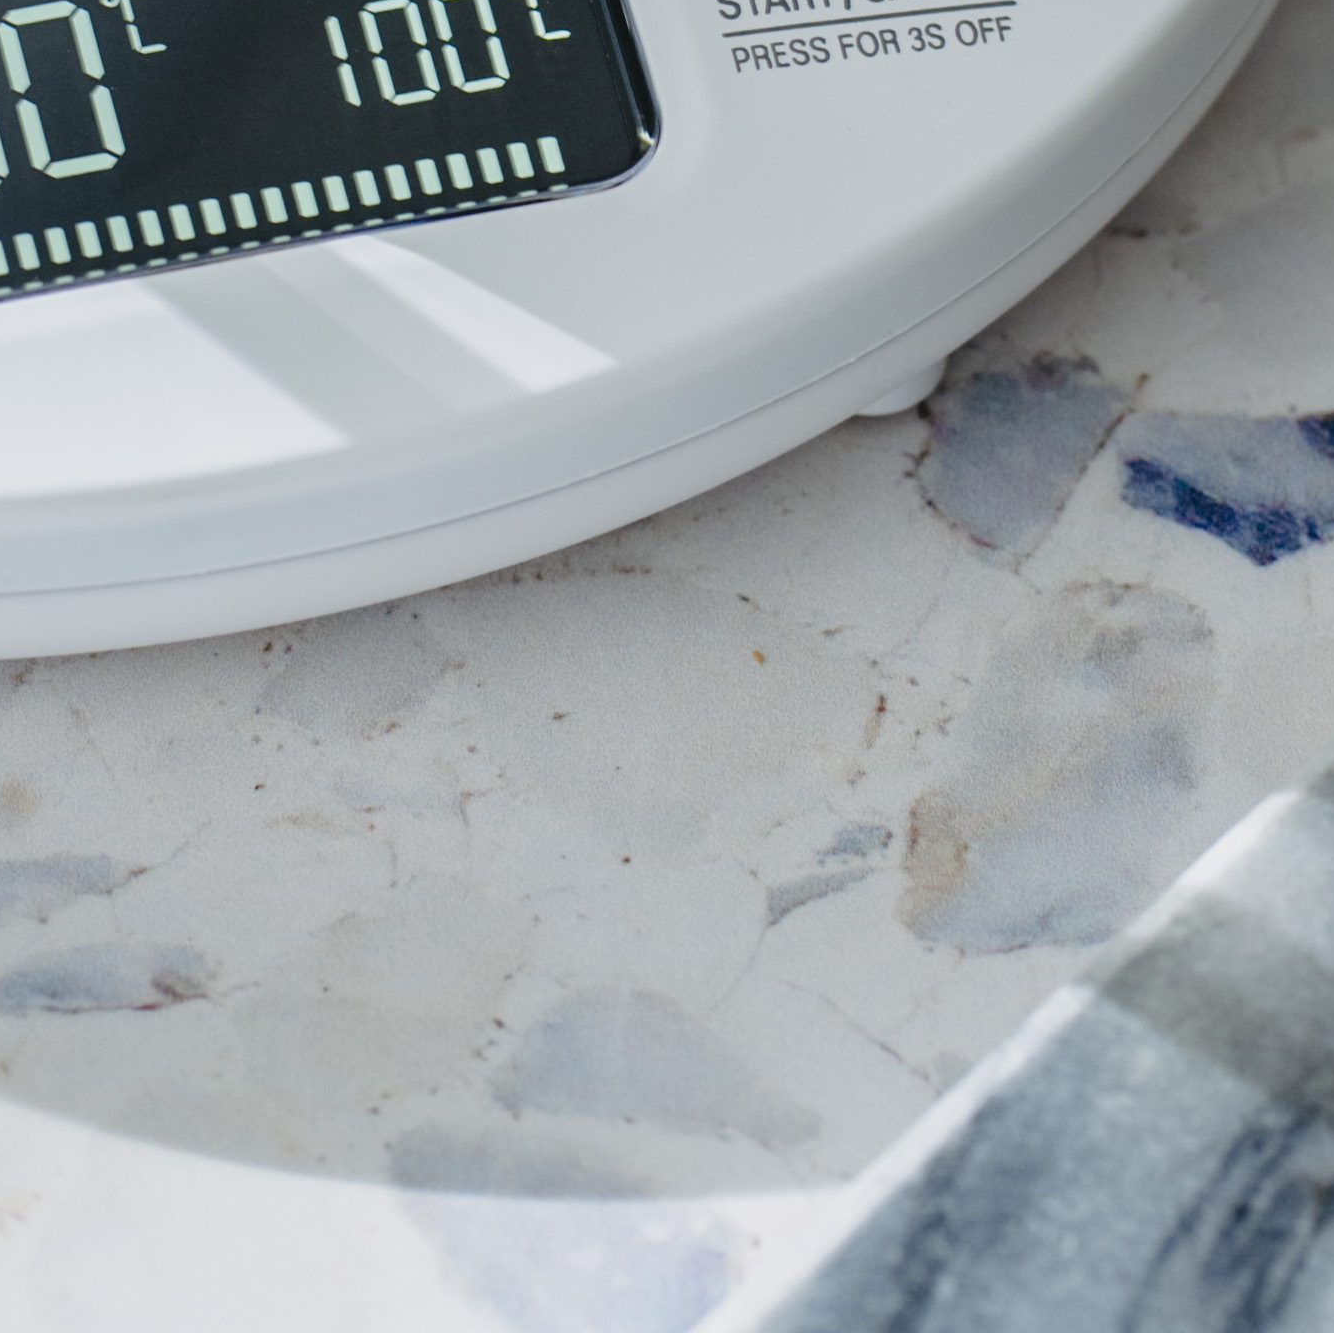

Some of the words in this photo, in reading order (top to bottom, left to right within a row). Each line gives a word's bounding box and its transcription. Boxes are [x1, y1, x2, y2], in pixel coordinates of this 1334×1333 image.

[731, 36, 831, 73] PRESS
[837, 29, 901, 59] FOR
[907, 23, 946, 52] 3S
[954, 16, 1012, 46] OFF
